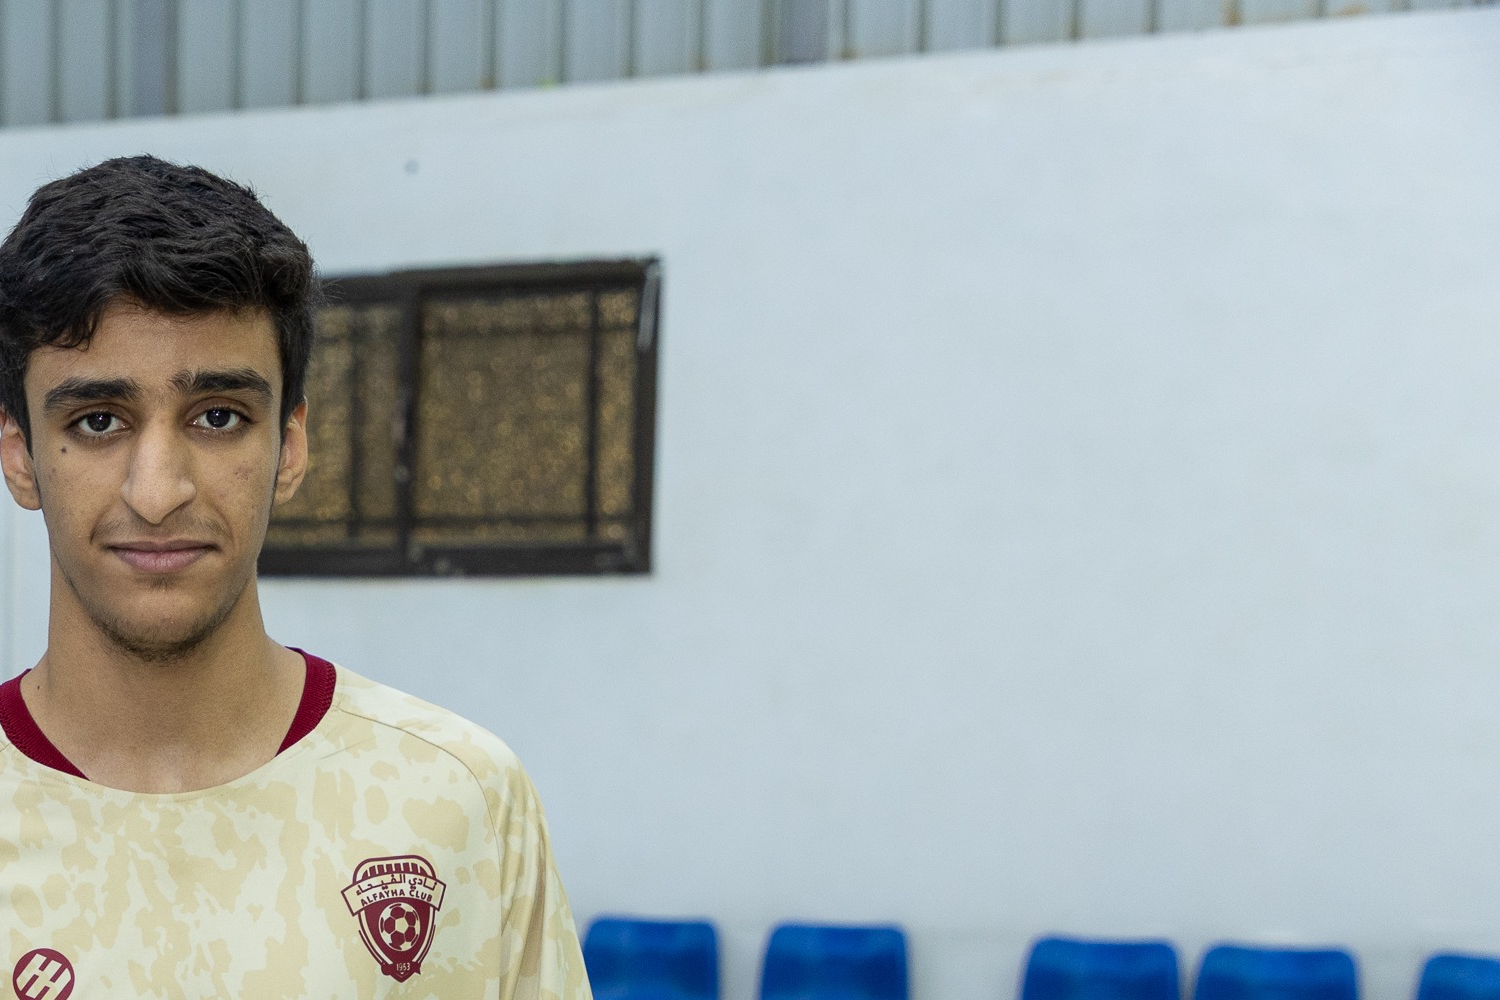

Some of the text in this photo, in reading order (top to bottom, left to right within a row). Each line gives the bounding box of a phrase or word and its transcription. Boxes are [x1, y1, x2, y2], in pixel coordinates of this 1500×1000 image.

[356, 873, 438, 896] نادي الفيحاء
[360, 889, 433, 907] ALFAYHA CLUB
